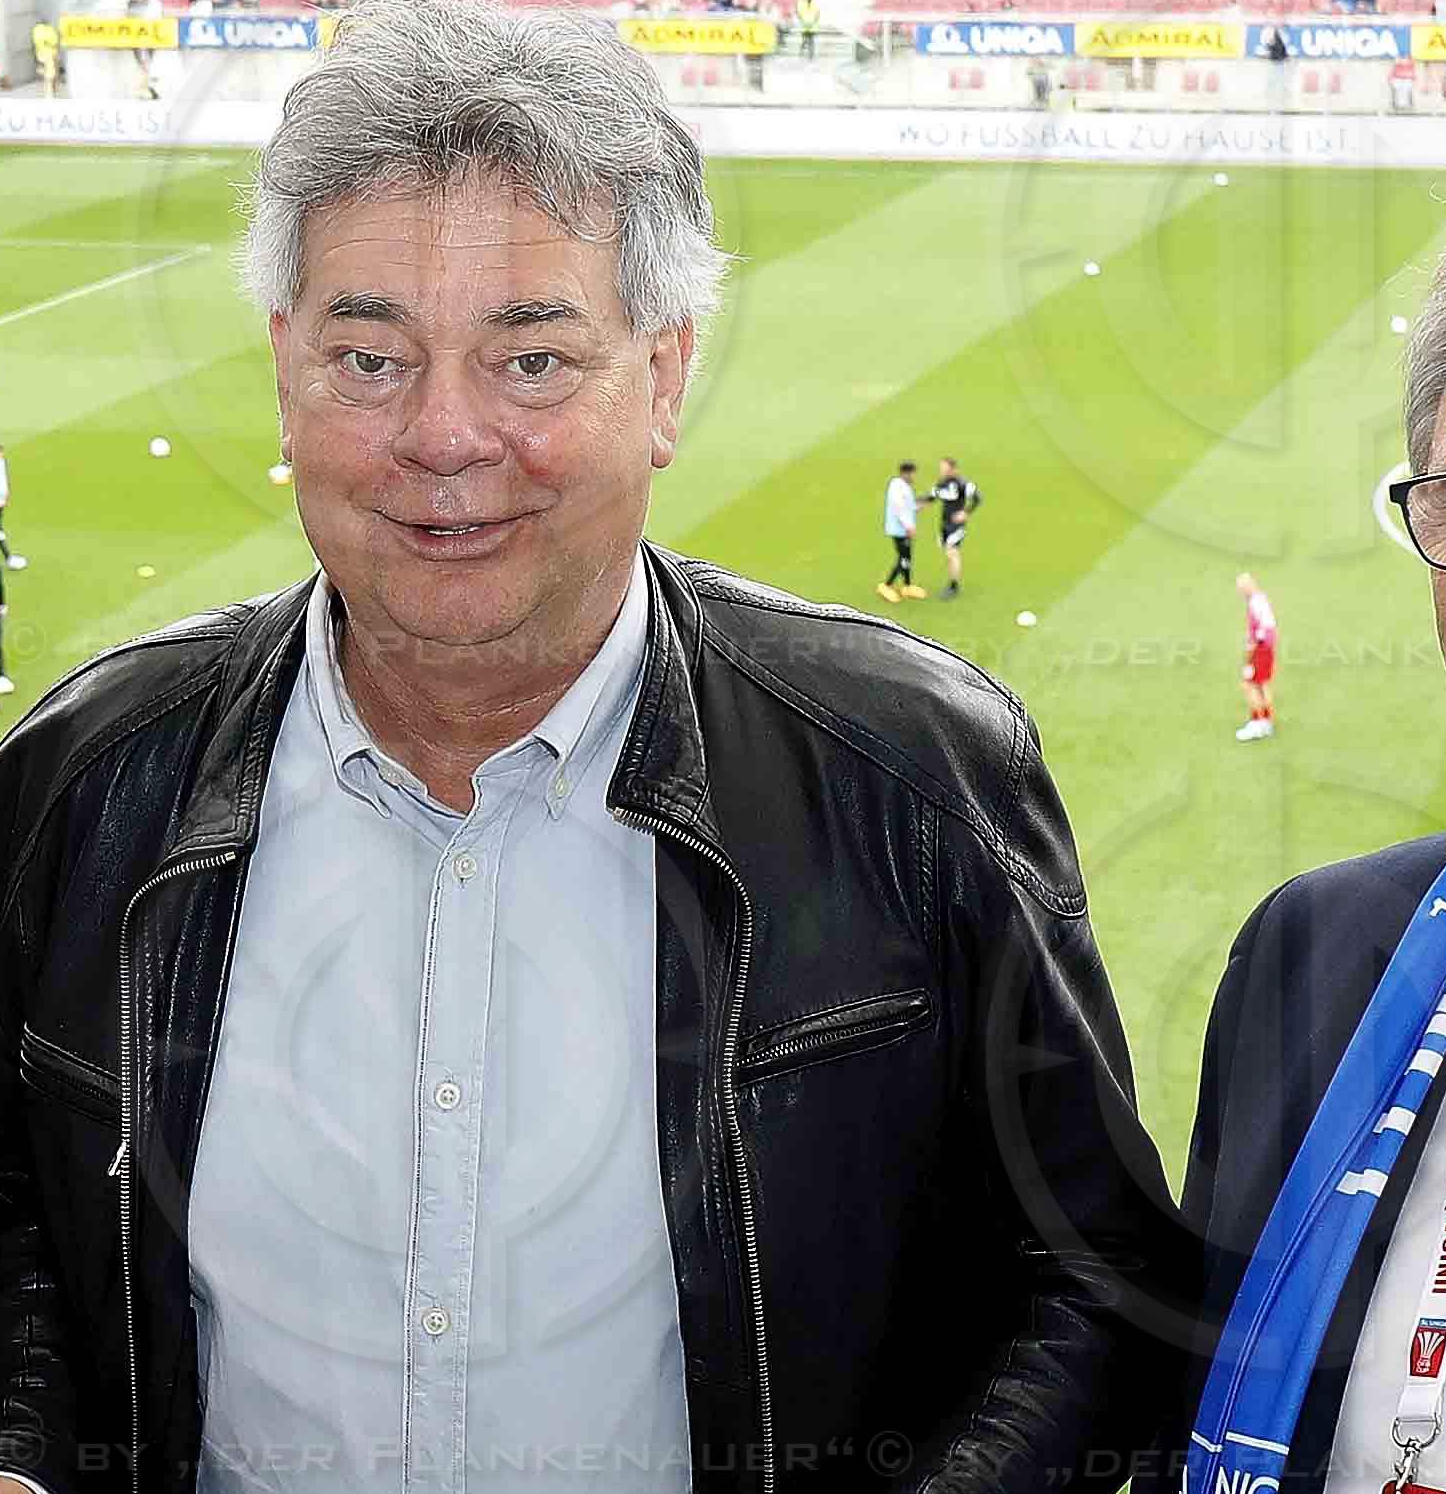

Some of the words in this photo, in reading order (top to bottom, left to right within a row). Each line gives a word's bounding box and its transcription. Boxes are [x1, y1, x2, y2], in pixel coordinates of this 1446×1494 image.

[66, 23, 165, 43] DMIRAL
[223, 19, 310, 47] UNIQA
[630, 25, 759, 45] ADMIRAL
[971, 24, 1065, 55] UNIQA
[1090, 28, 1226, 48] ADMIRAL
[1301, 26, 1399, 57] UNIQA
[960, 126, 1109, 150] FUSSBALL
[1130, 127, 1171, 151] ZU
[1185, 128, 1294, 152] HAUSE
